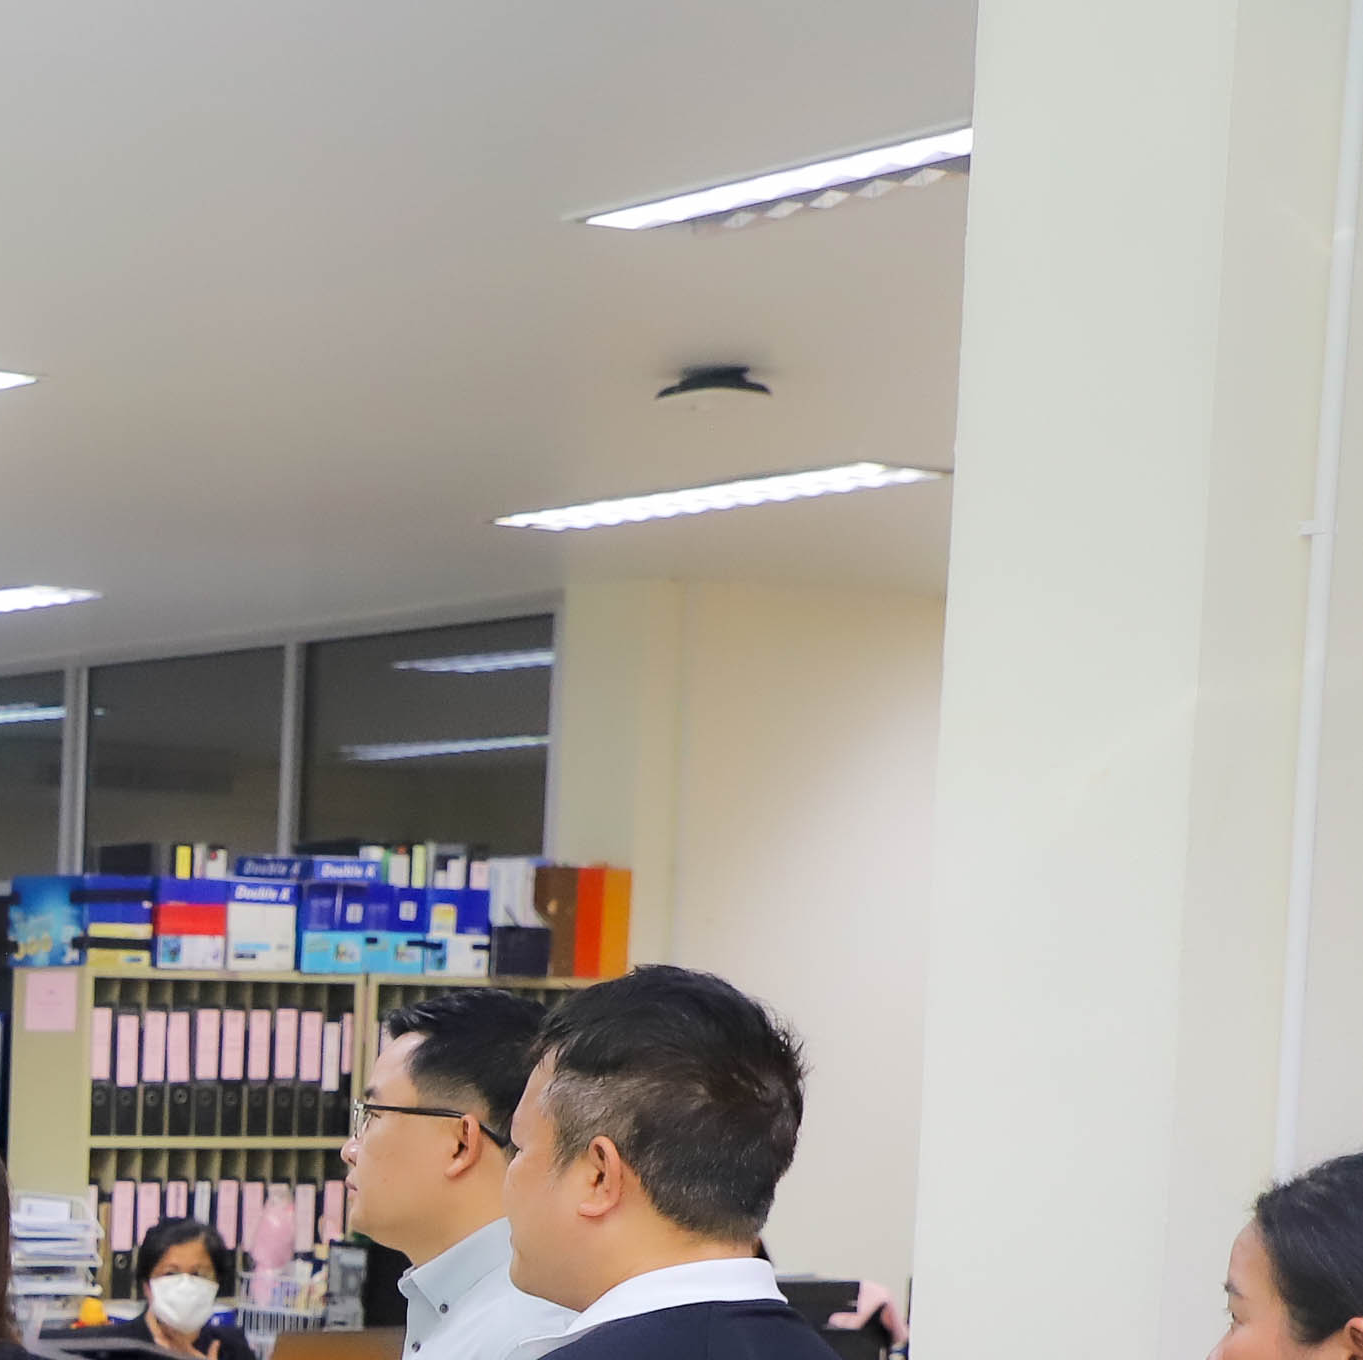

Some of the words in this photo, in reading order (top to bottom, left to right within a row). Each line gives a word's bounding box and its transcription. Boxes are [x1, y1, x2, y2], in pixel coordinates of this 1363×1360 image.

[321, 862, 364, 878] Double
[234, 884, 277, 900] Double
[278, 886, 291, 901] A
